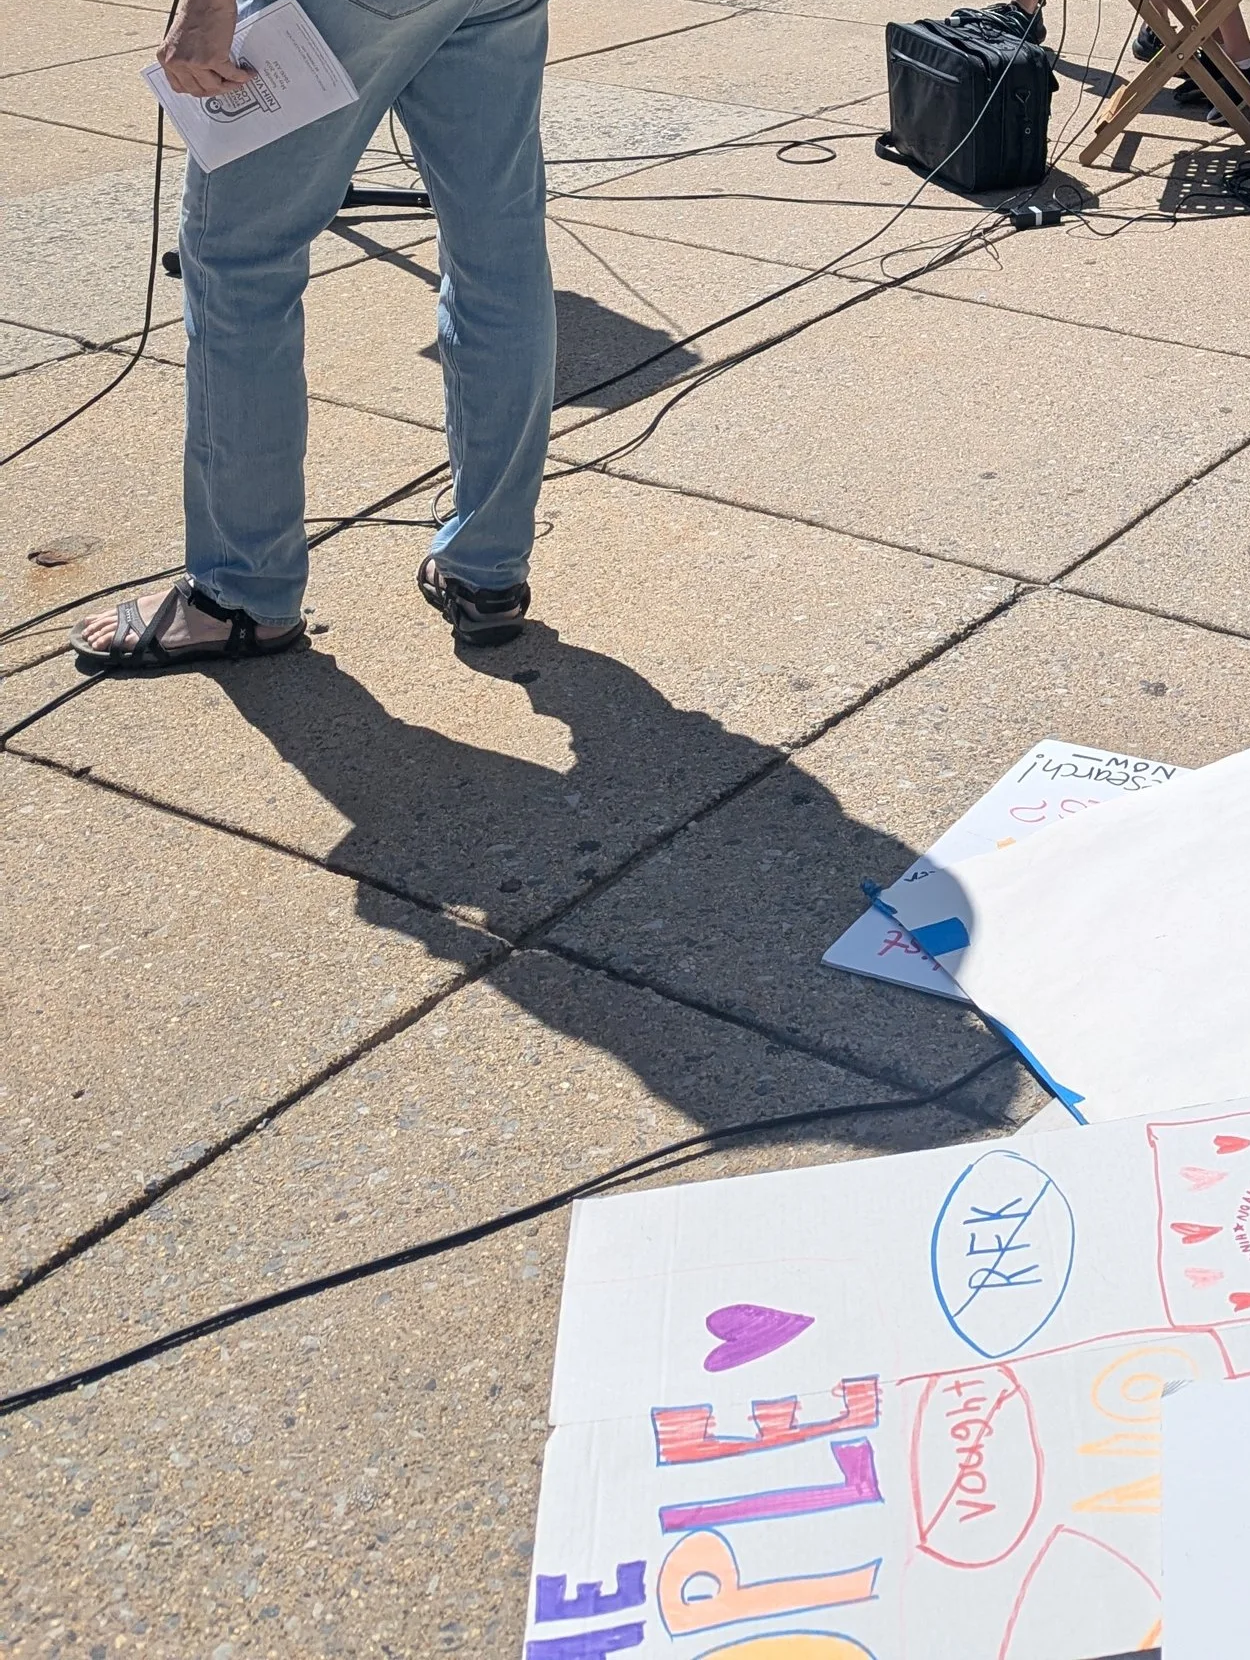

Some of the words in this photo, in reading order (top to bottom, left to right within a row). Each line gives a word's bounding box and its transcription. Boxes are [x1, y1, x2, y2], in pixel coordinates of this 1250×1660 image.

[261, 89, 276, 107] NIH
[963, 1197, 1042, 1291] RFK
[651, 1374, 885, 1660] PLE
